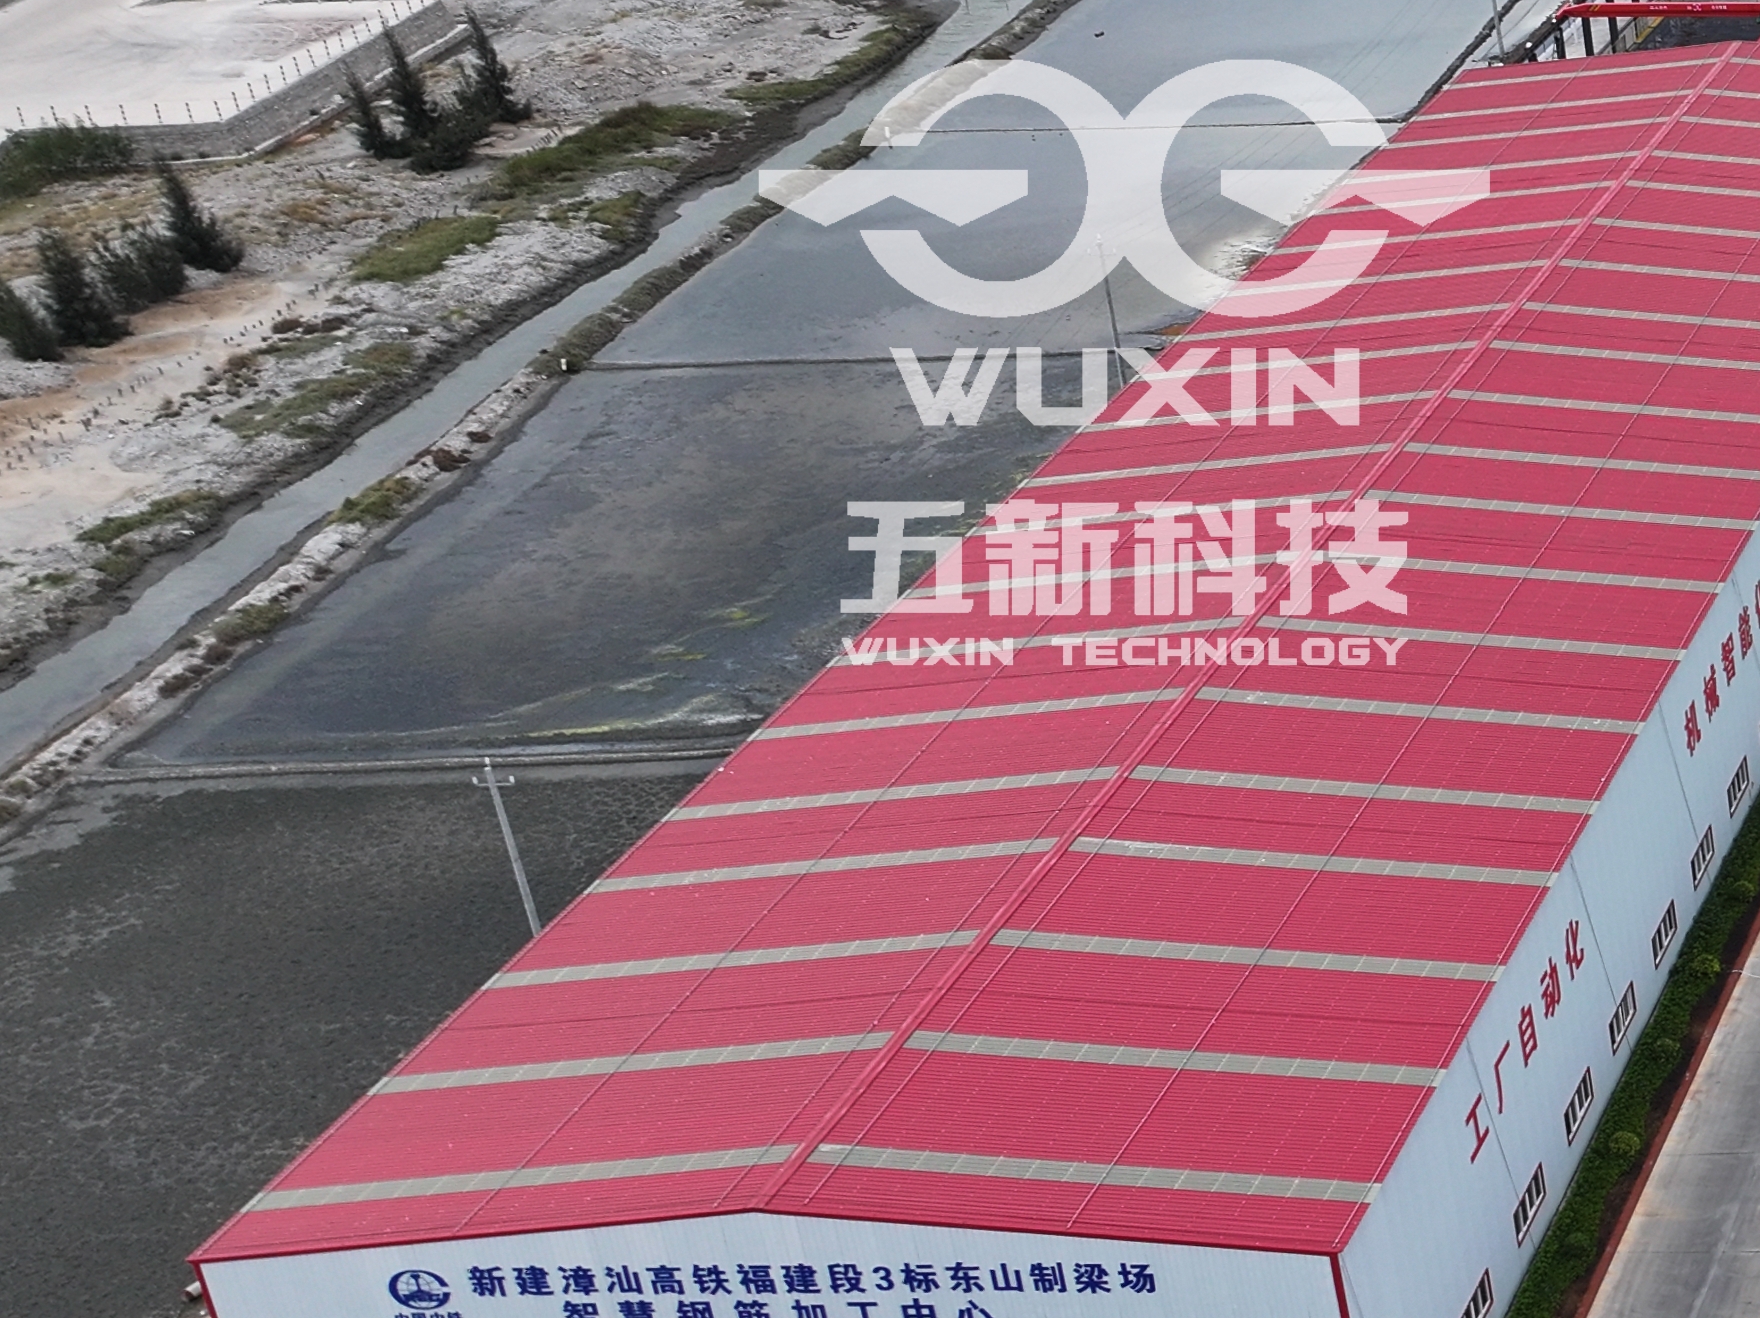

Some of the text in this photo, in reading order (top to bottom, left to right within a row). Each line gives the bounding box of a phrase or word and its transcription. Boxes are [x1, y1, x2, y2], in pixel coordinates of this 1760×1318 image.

[1464, 918, 1585, 1163] 工厂自动化
[469, 1262, 1157, 1297] 新建漳汕高铁福建段3标东山制梁场
